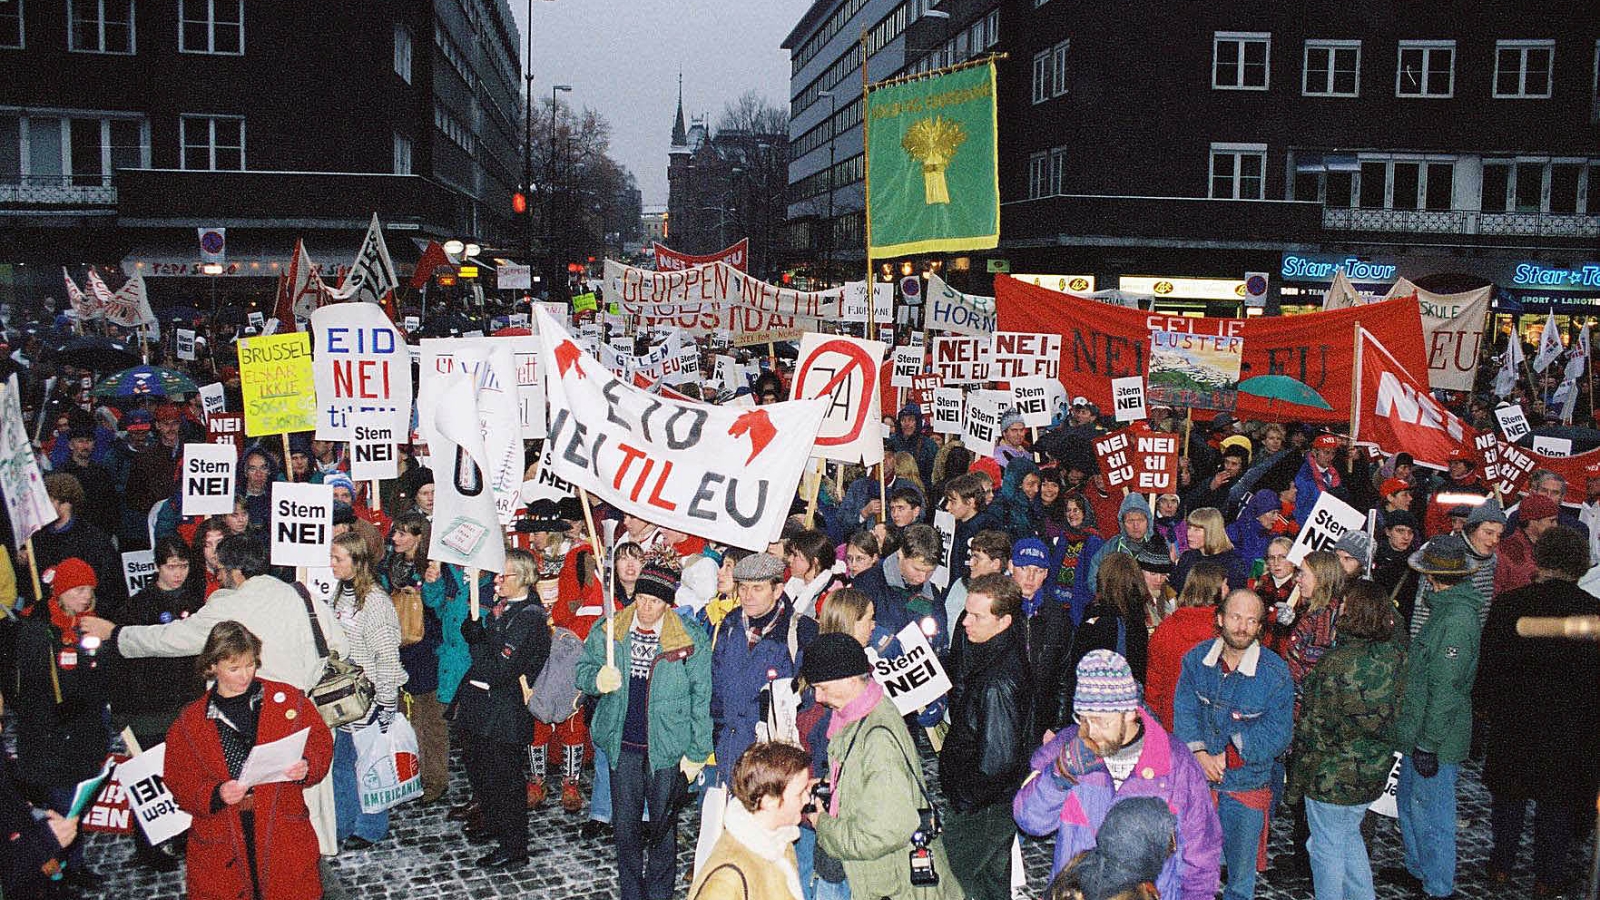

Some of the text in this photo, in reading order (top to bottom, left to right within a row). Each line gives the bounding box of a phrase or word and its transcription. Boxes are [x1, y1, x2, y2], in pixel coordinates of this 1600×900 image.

[660, 253, 686, 269] NEI
[1282, 256, 1395, 278] Star Tour
[1513, 264, 1567, 284] Star
[623, 263, 729, 303] GLOPPEN
[742, 276, 779, 312] NEI
[1521, 296, 1550, 304] SPORT
[327, 328, 395, 354] EID
[1154, 333, 1238, 353] LUSTER
[242, 341, 313, 364] BRUSSEL
[897, 354, 921, 364] Stem
[1074, 328, 1142, 376] NEI
[1428, 331, 1484, 372] EU
[662, 357, 680, 376] EU
[681, 362, 698, 374] NEI
[895, 365, 920, 377] NEI
[938, 364, 990, 380] TIL EU
[996, 359, 1028, 378] TIL
[333, 360, 390, 399] NEI
[914, 377, 942, 389] NEI
[205, 394, 222, 407] Stem
[1015, 387, 1045, 398] Stem
[1117, 387, 1141, 396] Stem
[936, 396, 959, 408] Stem
[1016, 399, 1047, 414] NEI
[1118, 397, 1142, 409] NEI
[1375, 371, 1463, 444] NEI
[602, 379, 709, 450] EID
[936, 409, 959, 422] NEI
[971, 407, 995, 425] Stem
[1501, 415, 1523, 425] Stem
[210, 418, 241, 432] NEI
[355, 426, 392, 440] Stem
[969, 421, 993, 442] NEI
[1506, 423, 1528, 437] NEI
[355, 444, 392, 462] NEI
[1096, 433, 1128, 456] NEI
[1138, 437, 1174, 453] NEI
[1537, 447, 1566, 457] Stem
[189, 459, 230, 473] Stem
[1107, 451, 1127, 469] til
[1144, 455, 1166, 470] til
[1503, 446, 1535, 473] NEI
[1108, 465, 1134, 486] EU
[1140, 472, 1169, 487] EU
[1501, 463, 1520, 481] til
[188, 478, 229, 496] NEI
[612, 443, 676, 512] TIL
[687, 471, 769, 528] EU
[279, 500, 326, 518] Stem
[278, 522, 325, 545] NEI
[875, 644, 925, 676] Stem
[884, 659, 937, 698] NEI
